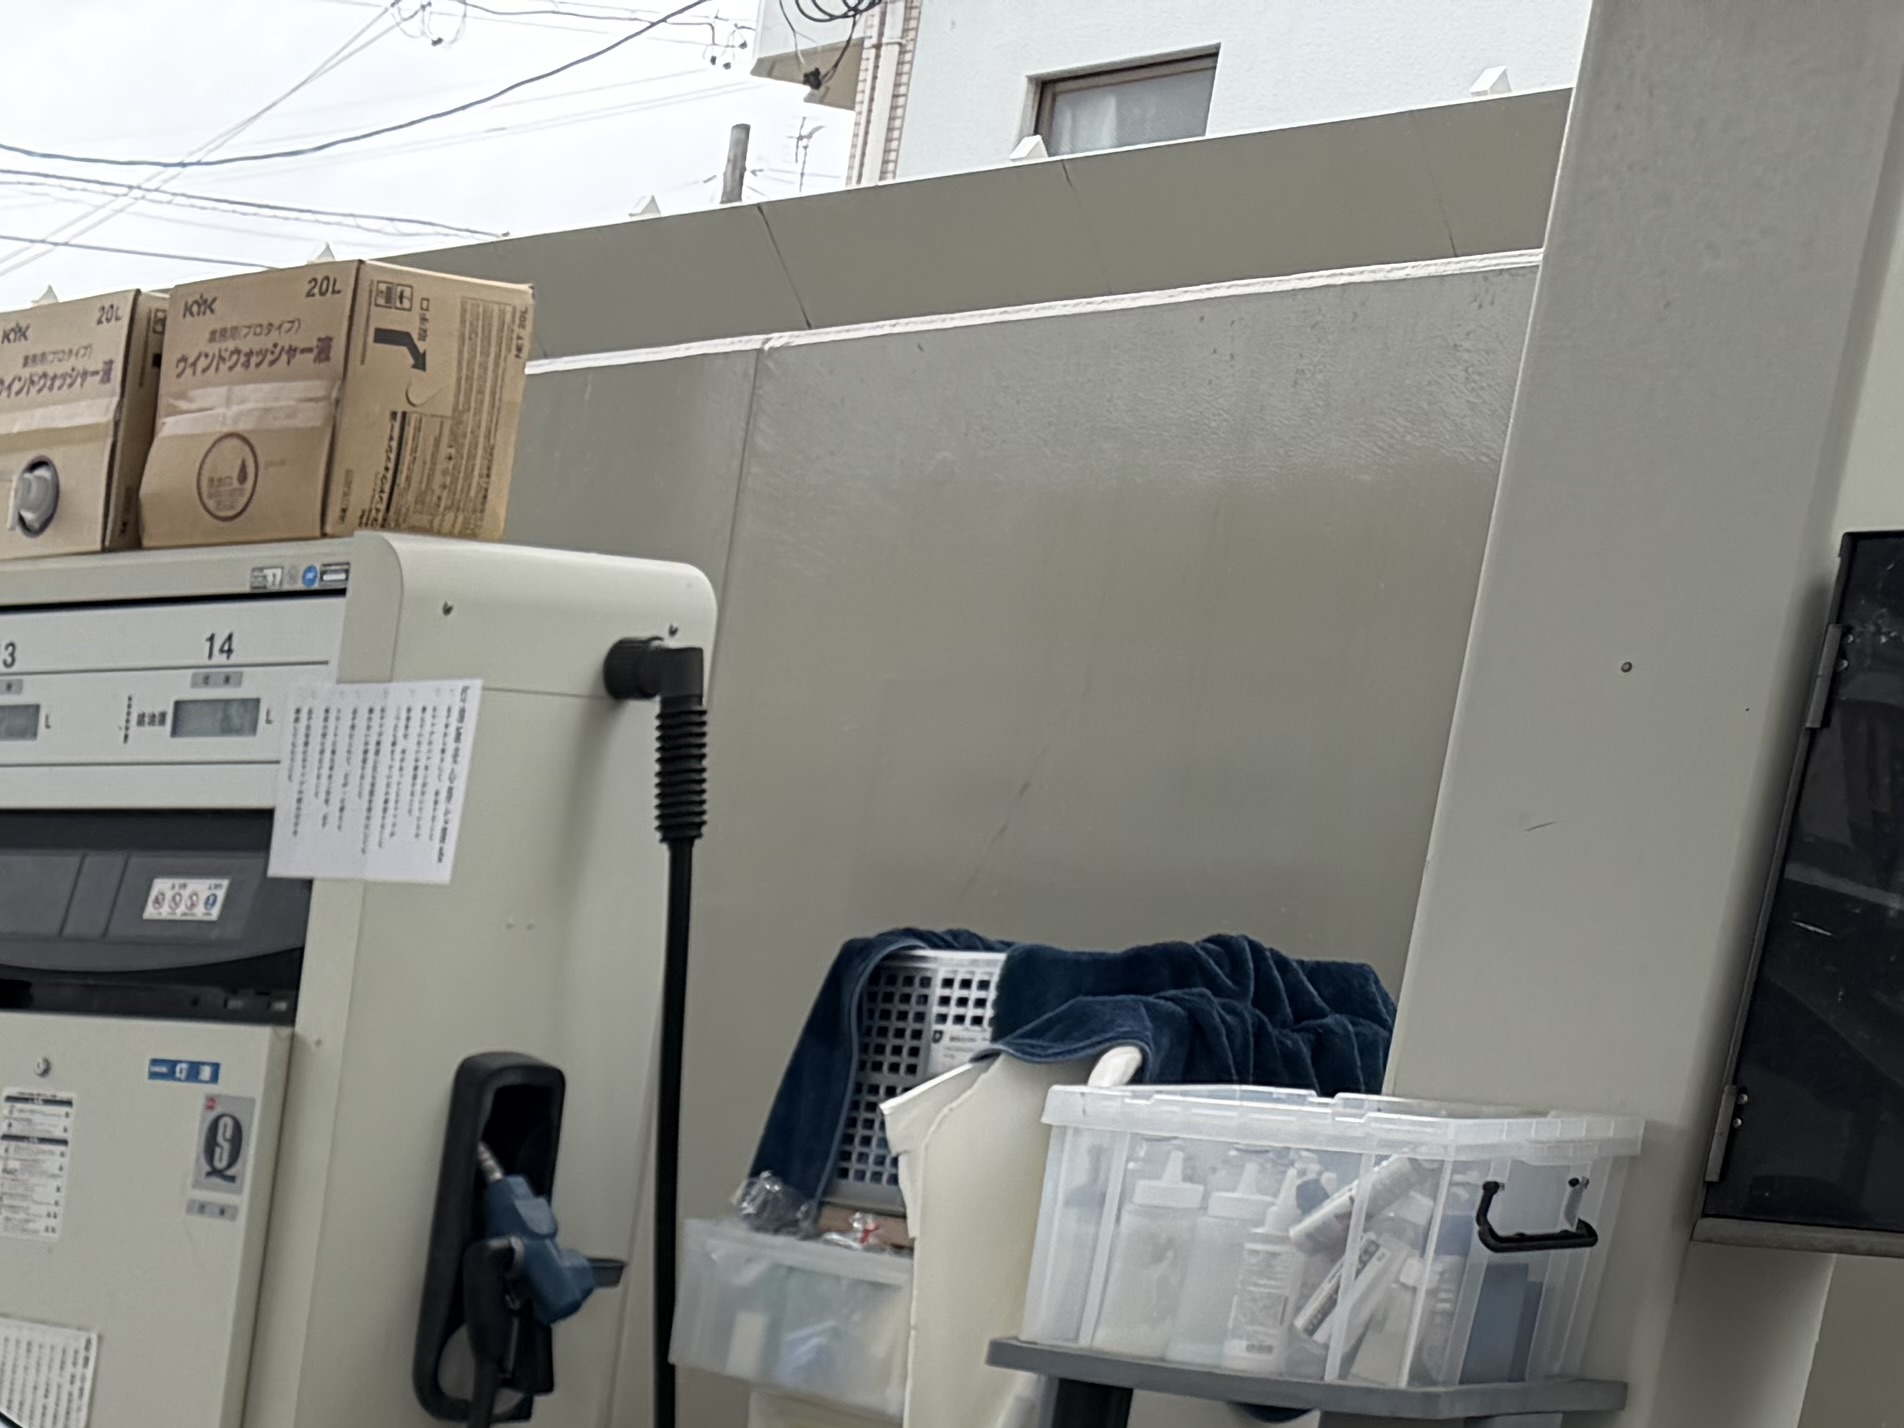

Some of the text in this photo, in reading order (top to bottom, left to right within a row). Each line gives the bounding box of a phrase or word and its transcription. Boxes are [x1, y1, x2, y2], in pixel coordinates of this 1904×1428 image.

[305, 275, 342, 298] 20L
[96, 303, 124, 326] 20L
[204, 632, 235, 661] 14
[44, 713, 52, 730] L
[264, 707, 274, 725] L
